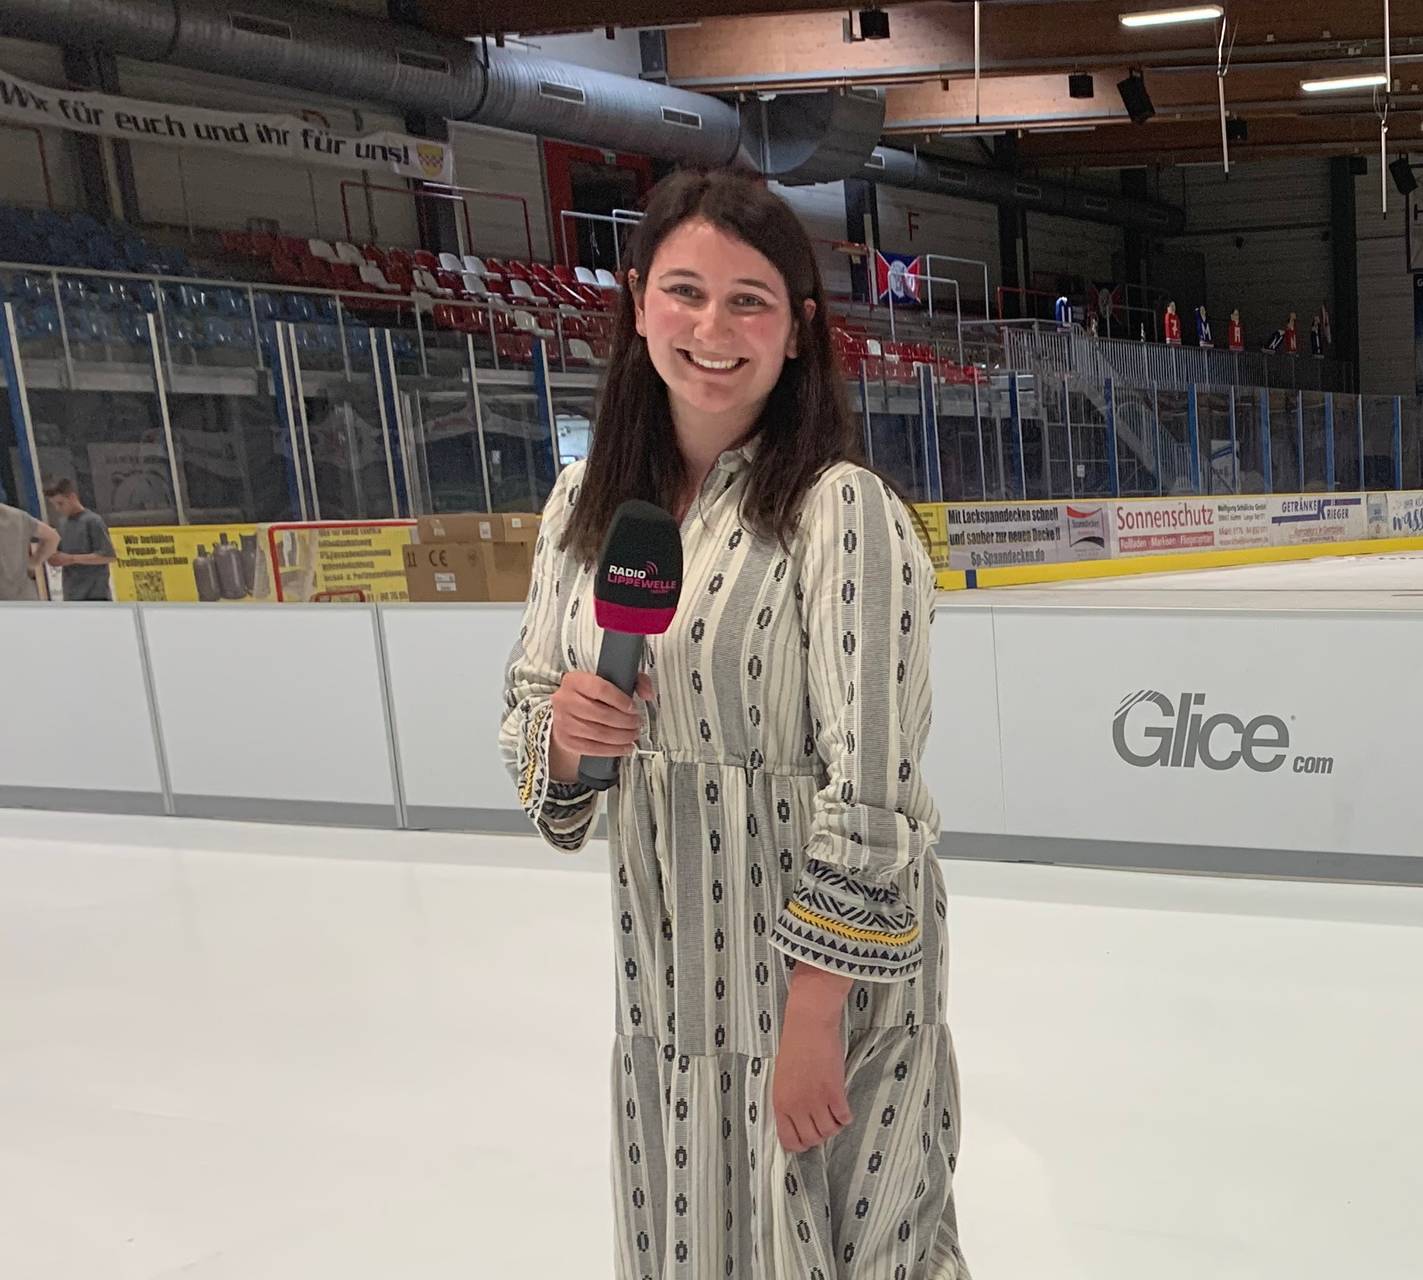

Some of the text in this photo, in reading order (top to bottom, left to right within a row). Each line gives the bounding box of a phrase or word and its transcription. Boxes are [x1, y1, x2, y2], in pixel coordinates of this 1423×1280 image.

[0, 80, 410, 165] Wir für euch und ihr für uns!
[1281, 497, 1318, 513] GETRÄNKE
[947, 506, 1059, 524] Mit Lackspanndecken schnell
[1116, 502, 1214, 530] Sonnenschutz
[949, 530, 965, 546] und
[966, 530, 994, 545] sauber
[995, 531, 1008, 543] zur
[1008, 530, 1031, 543] neuen
[1031, 527, 1055, 542] Decke
[608, 564, 647, 579] RADIO
[607, 573, 677, 590] LIPPEWELLE
[1112, 689, 1290, 773] Glice
[1292, 755, 1334, 775] com
